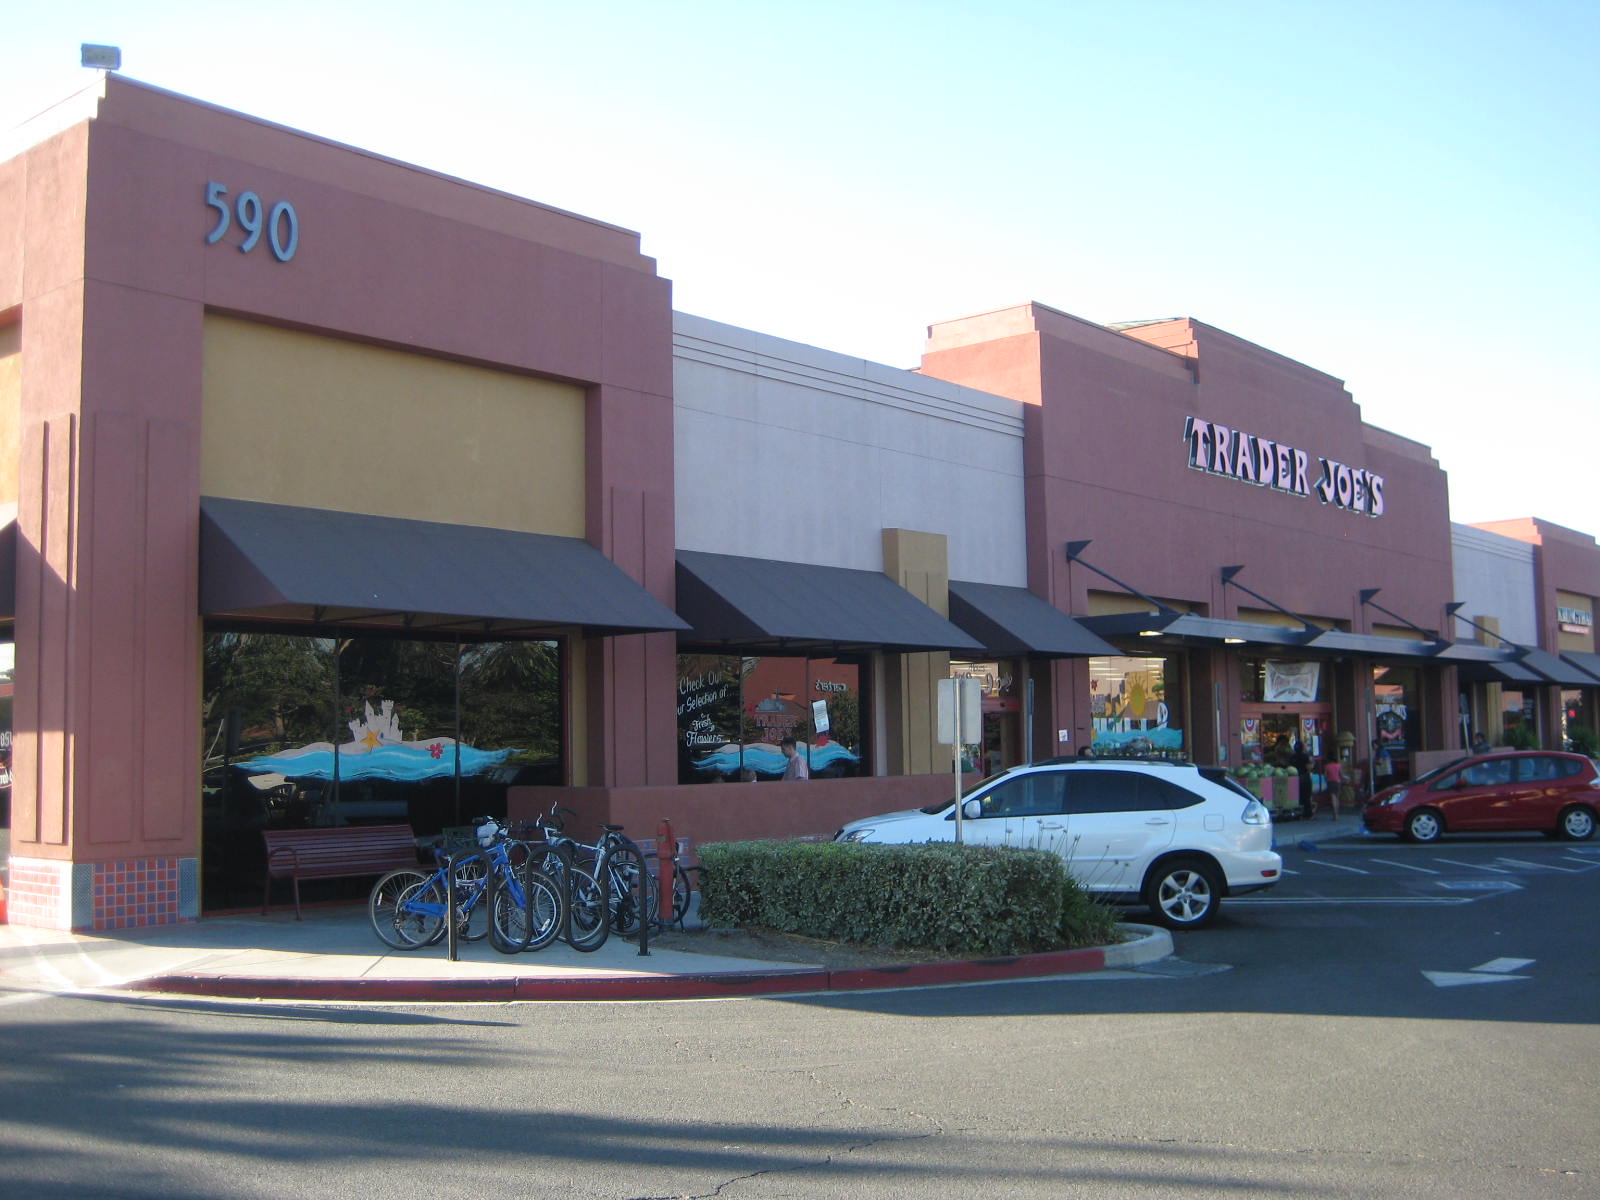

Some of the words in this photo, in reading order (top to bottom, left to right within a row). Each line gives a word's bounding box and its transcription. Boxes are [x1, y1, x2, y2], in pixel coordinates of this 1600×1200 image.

[205, 181, 298, 262] 590
[1184, 416, 1310, 497] TRADER
[1314, 457, 1384, 518] JOE'S
[679, 674, 705, 694] Check
[677, 704, 685, 716] ur
[686, 691, 717, 712] Selection
[686, 730, 723, 747] Flowers
